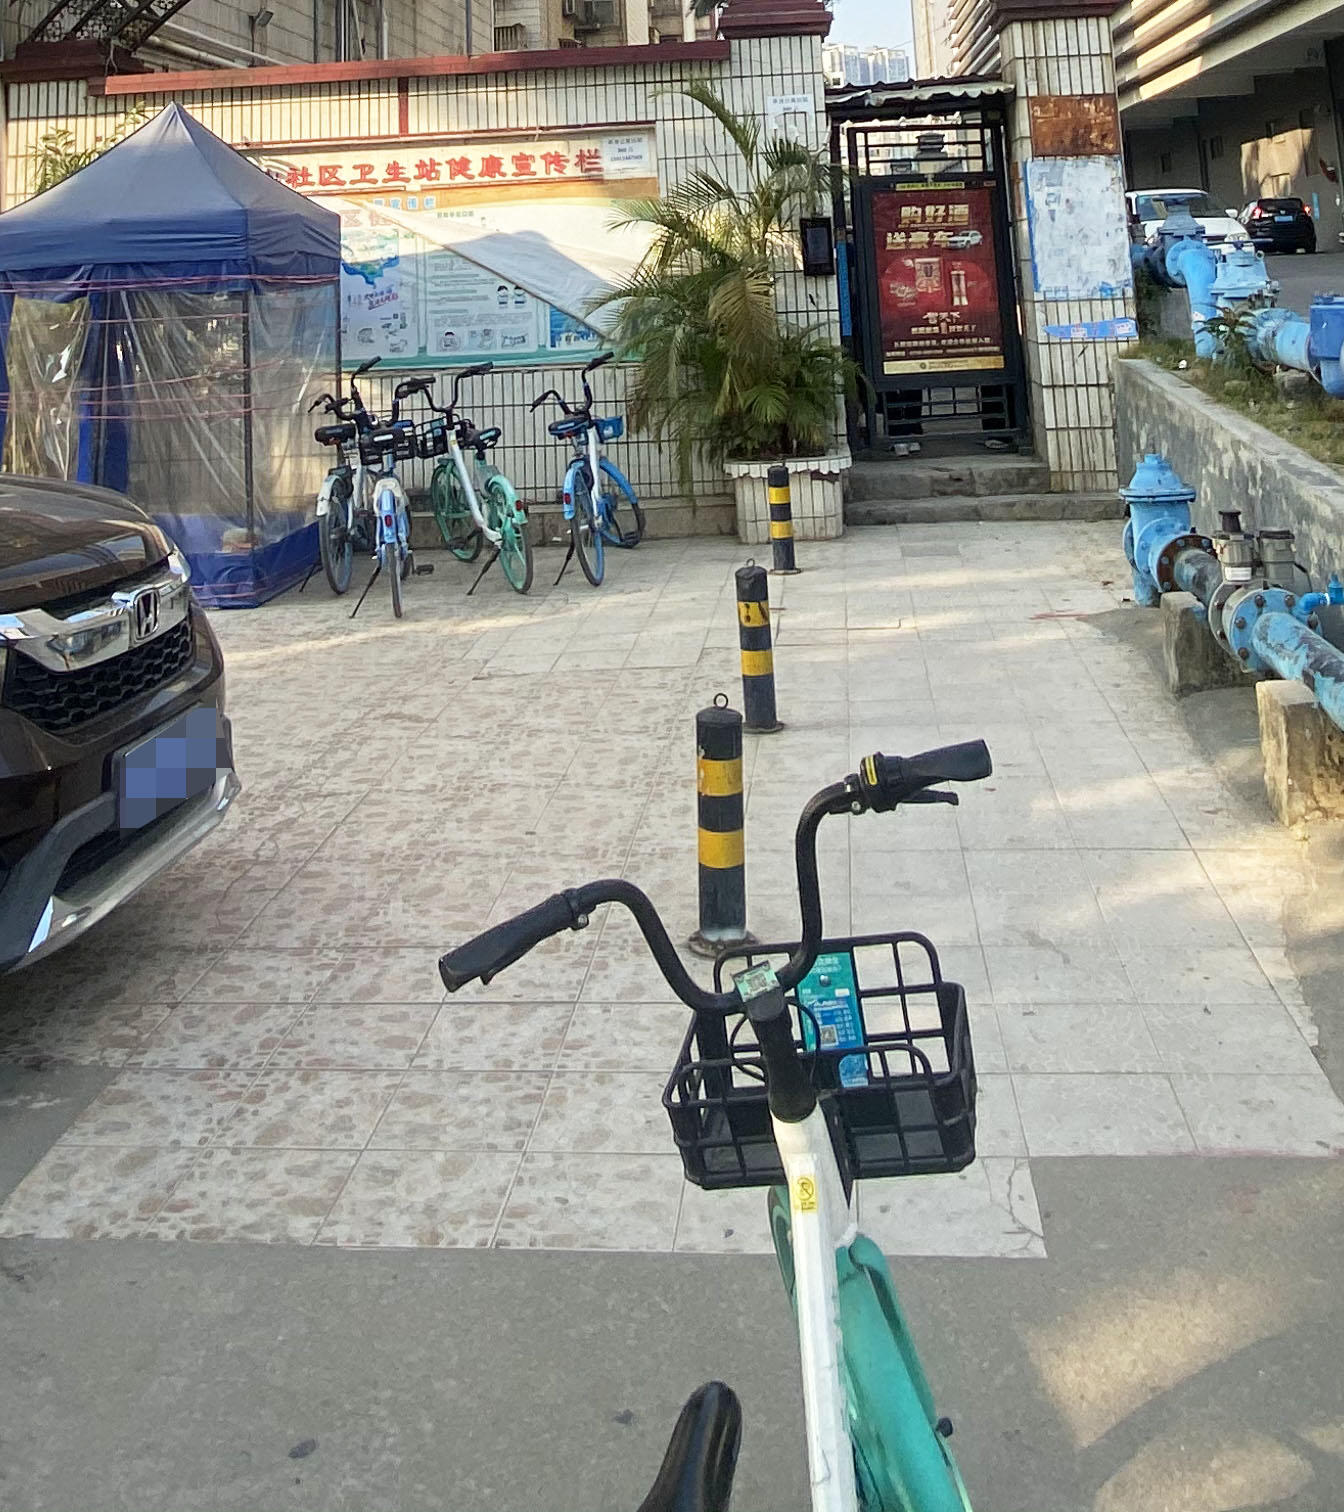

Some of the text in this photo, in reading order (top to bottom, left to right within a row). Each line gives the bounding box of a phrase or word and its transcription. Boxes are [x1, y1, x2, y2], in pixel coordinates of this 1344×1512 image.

[265, 147, 604, 188] 社区卫生站健康宣传栏
